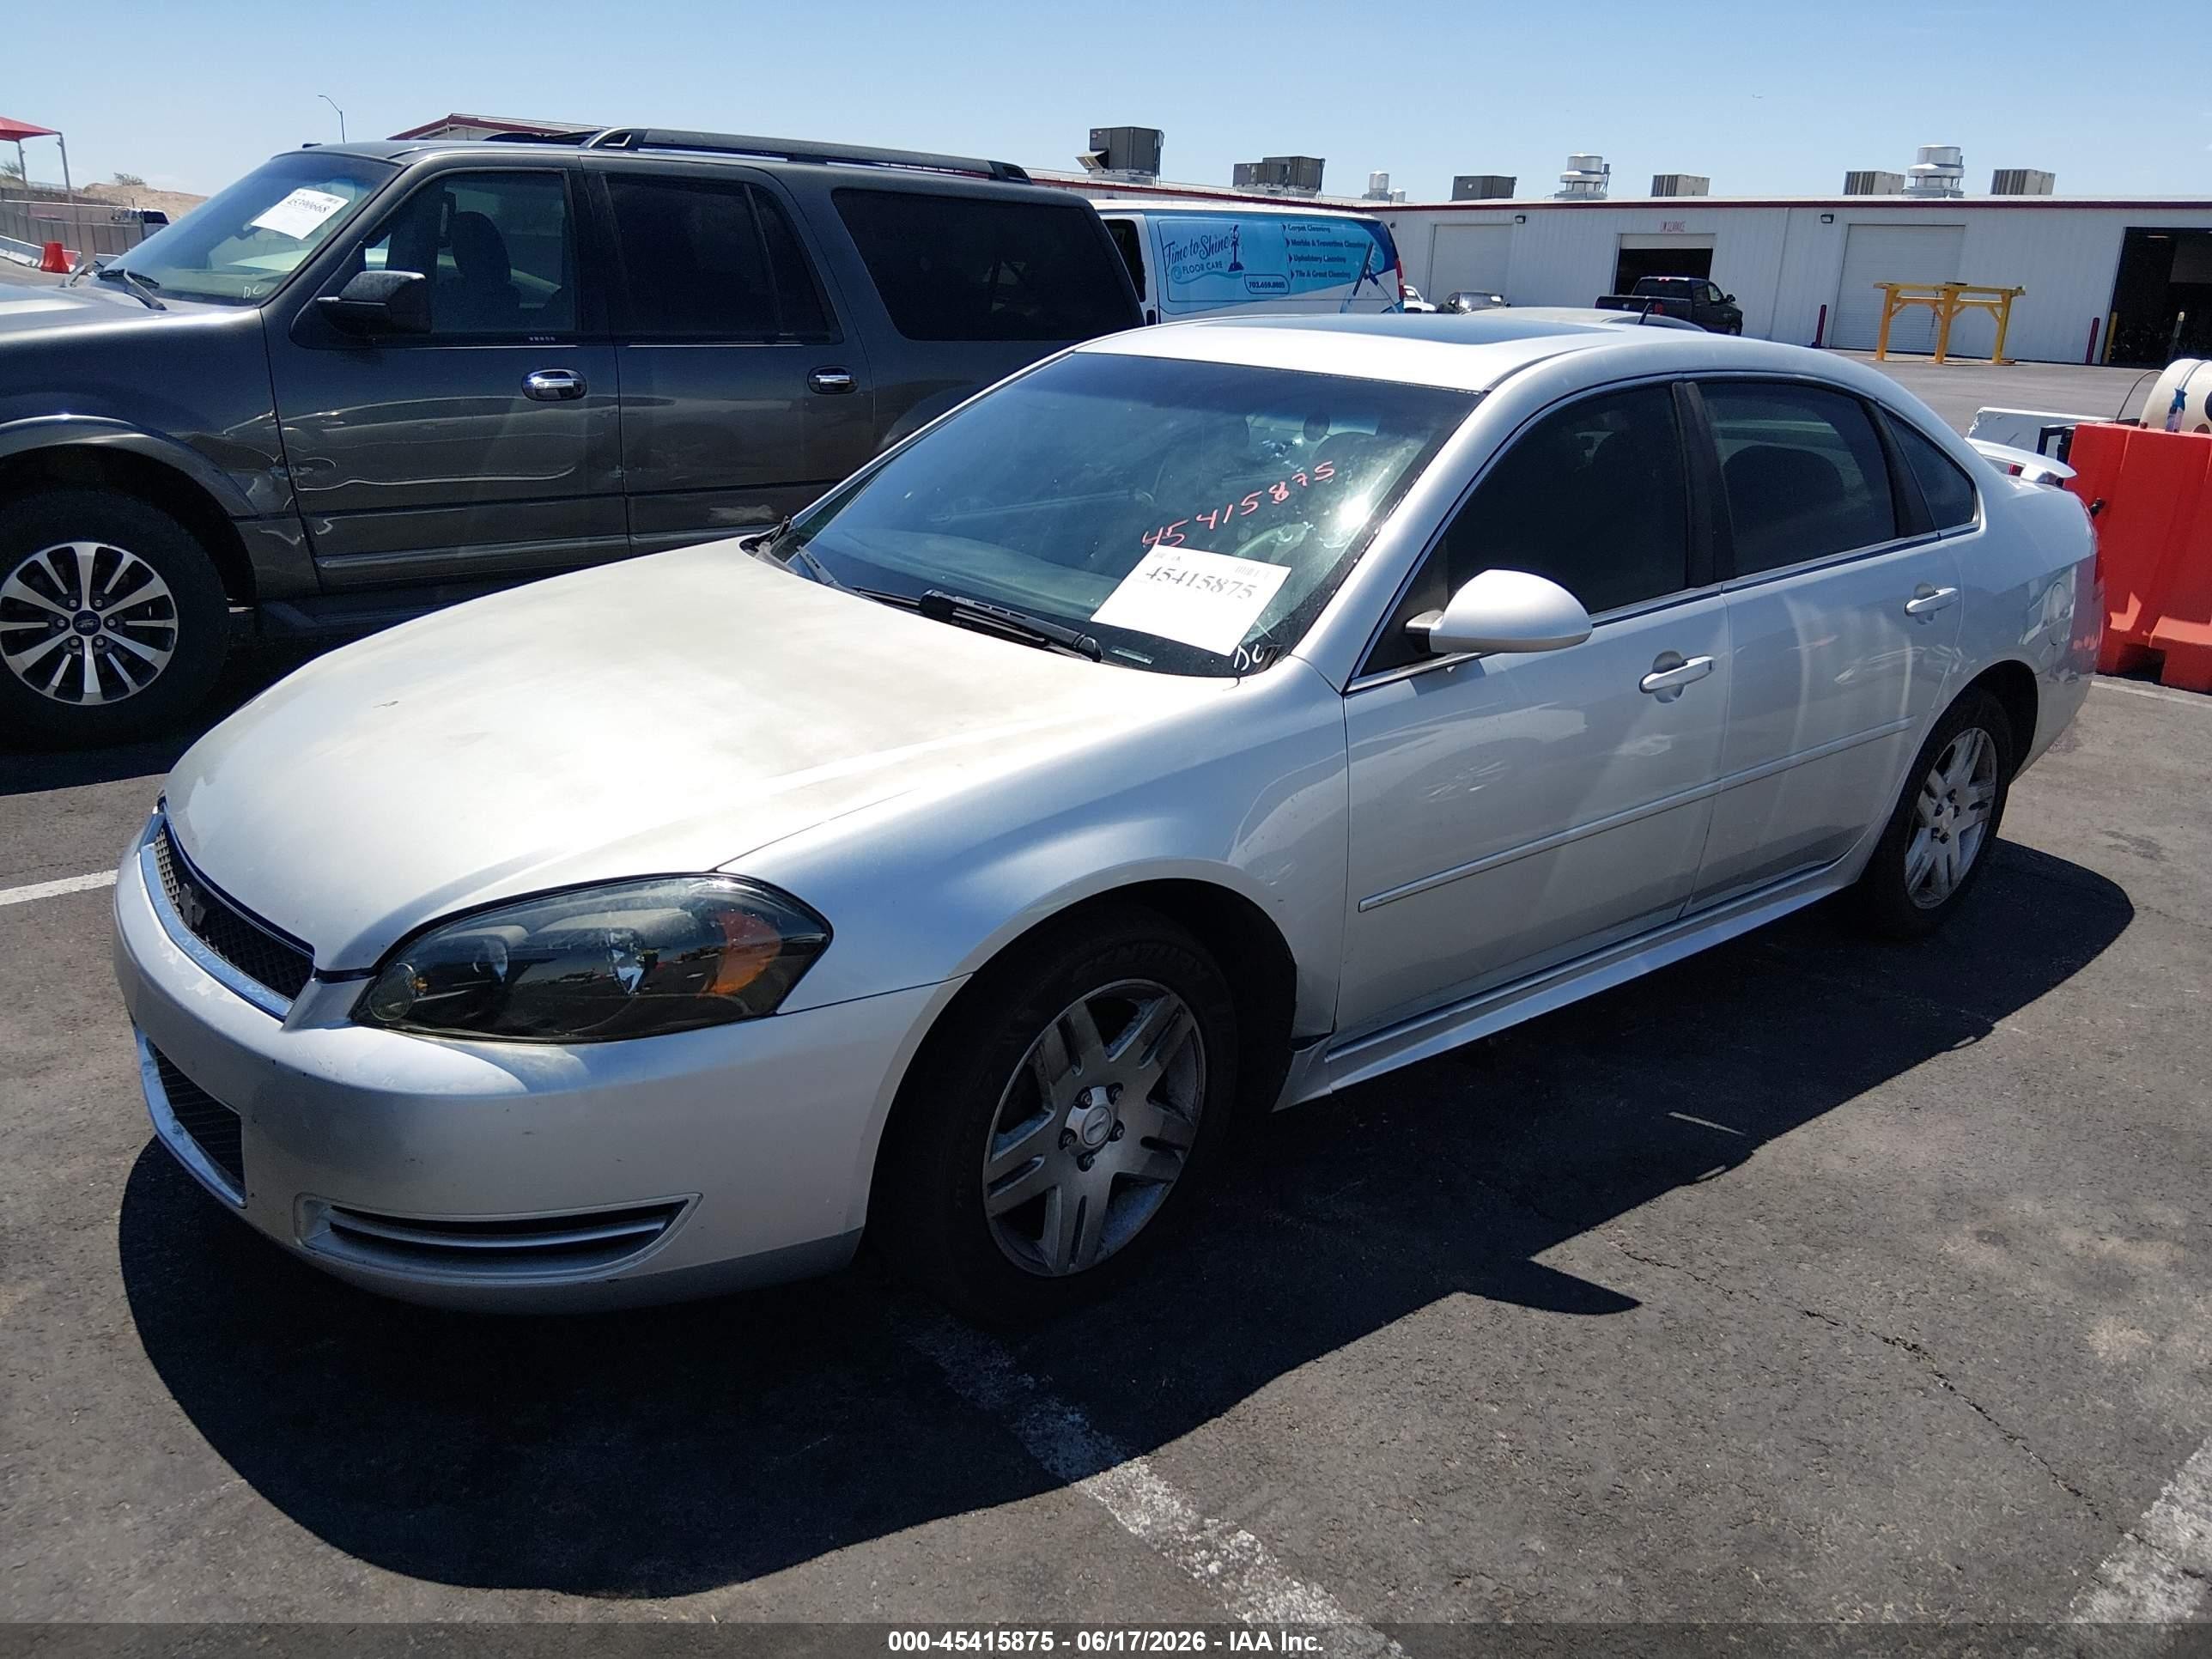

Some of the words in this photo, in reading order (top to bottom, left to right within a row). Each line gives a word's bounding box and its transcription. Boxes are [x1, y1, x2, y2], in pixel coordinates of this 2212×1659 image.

[1163, 240, 1188, 269] Time
[1190, 239, 1199, 256] to
[1199, 234, 1229, 259] Shine
[1293, 254, 1322, 264] Upholstery
[1182, 264, 1204, 274] FLOOR
[1206, 260, 1223, 270] CARE
[1328, 270, 1351, 279] Cleaning
[1146, 566, 1258, 599] 45415875
